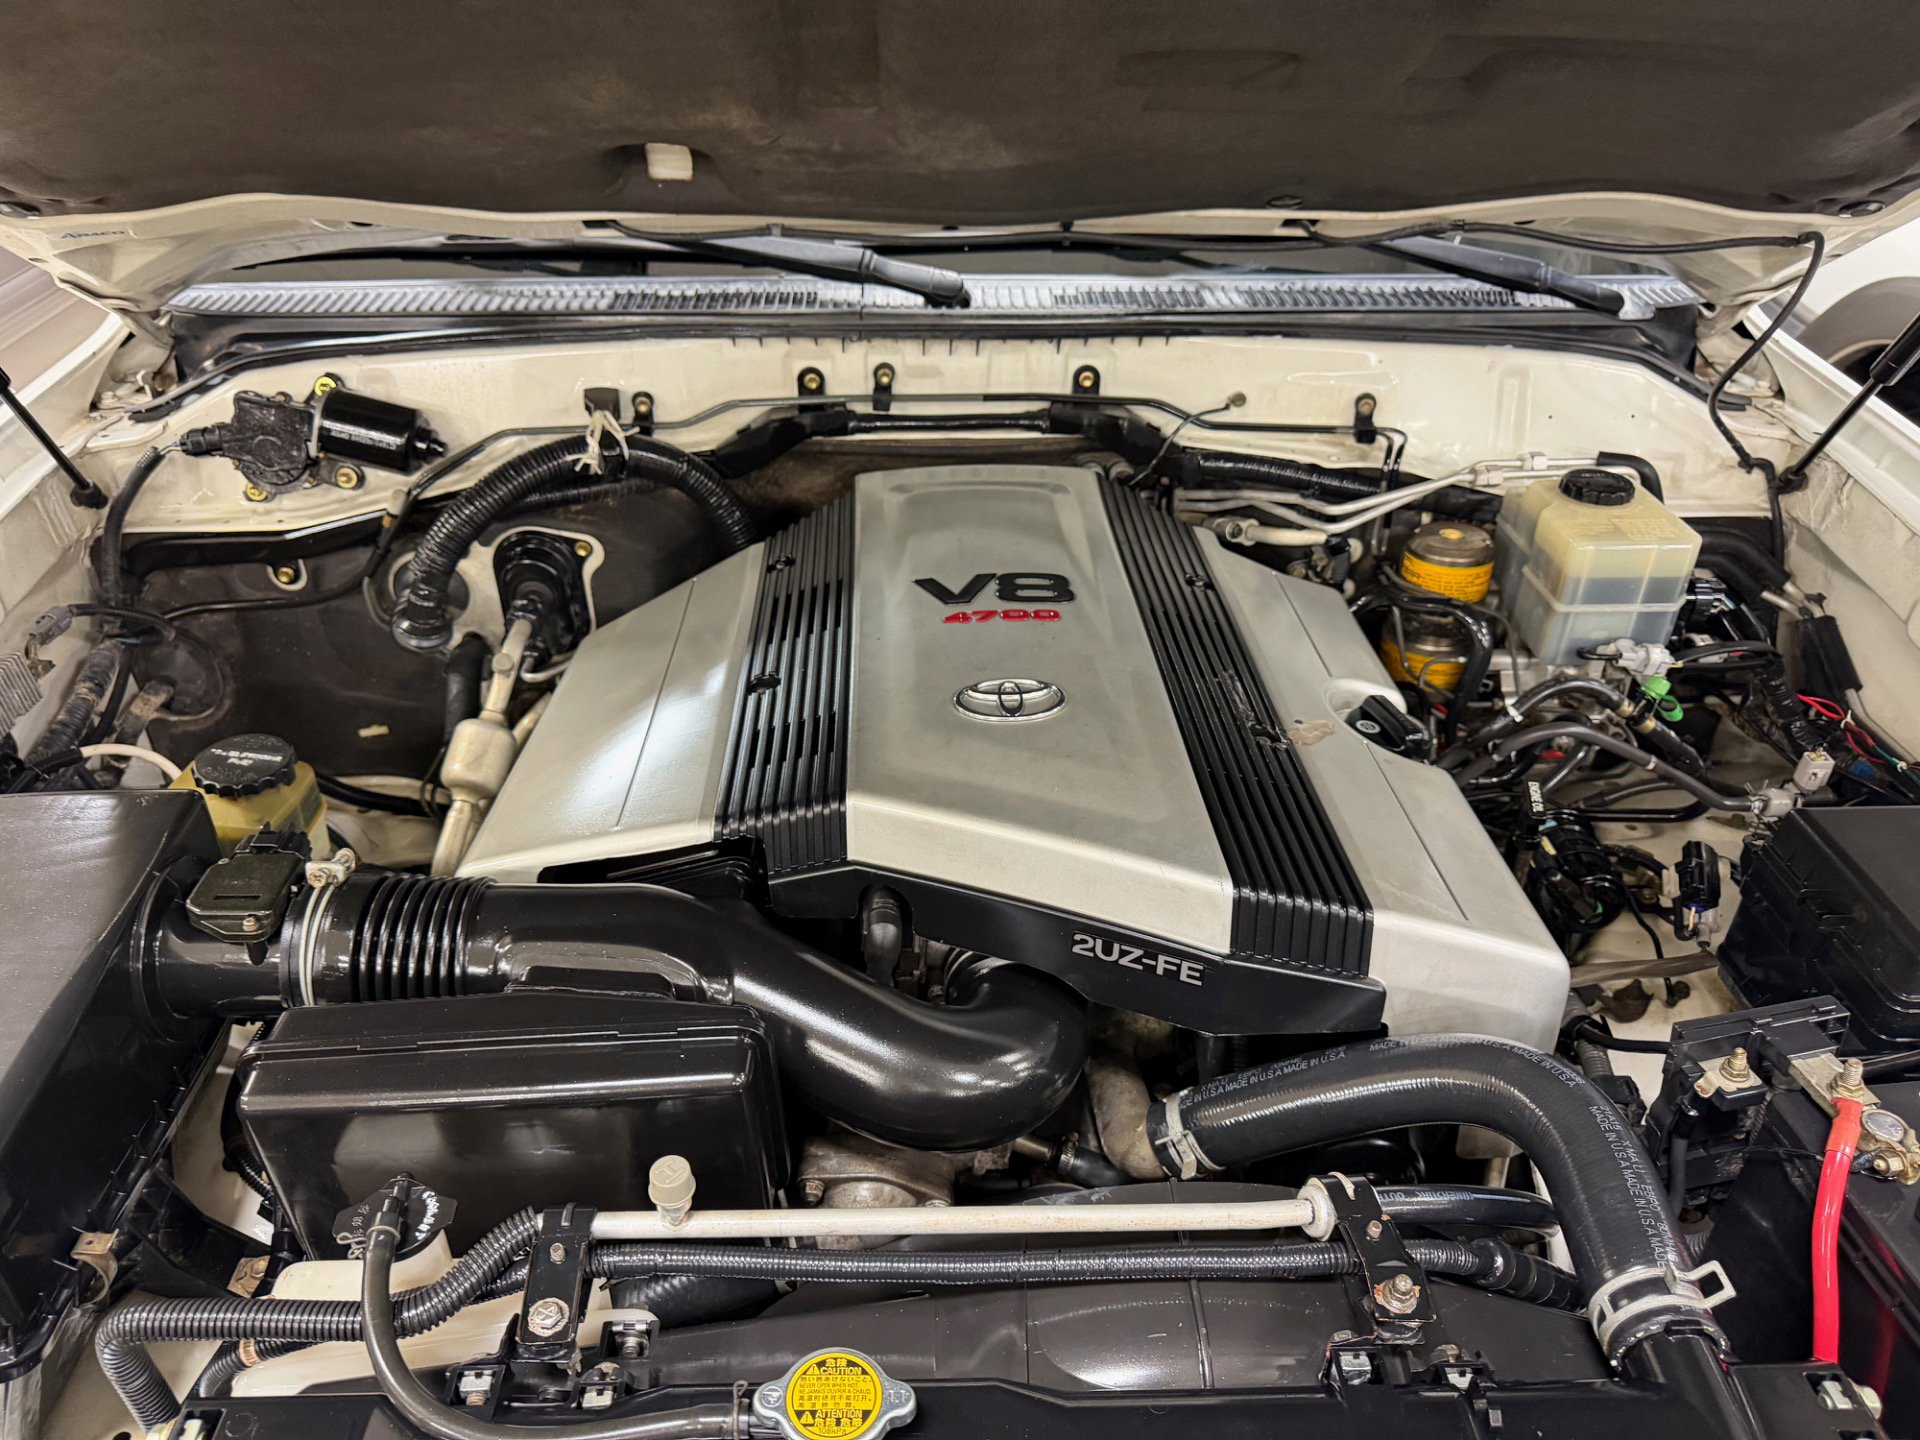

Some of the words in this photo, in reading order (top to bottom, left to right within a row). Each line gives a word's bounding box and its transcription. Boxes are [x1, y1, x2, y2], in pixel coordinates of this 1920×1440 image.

[912, 572, 1076, 605] V8
[942, 608, 1062, 624] 4700
[1072, 933, 1204, 986] 2UZ-FE
[1225, 1080, 1248, 1092] MADE
[1283, 1060, 1308, 1074] MADE
[1588, 1105, 1613, 1131] MADE
[1622, 1168, 1644, 1196] MADE
[820, 1366, 862, 1375] CAUTION
[816, 1409, 862, 1418] ATTENTION
